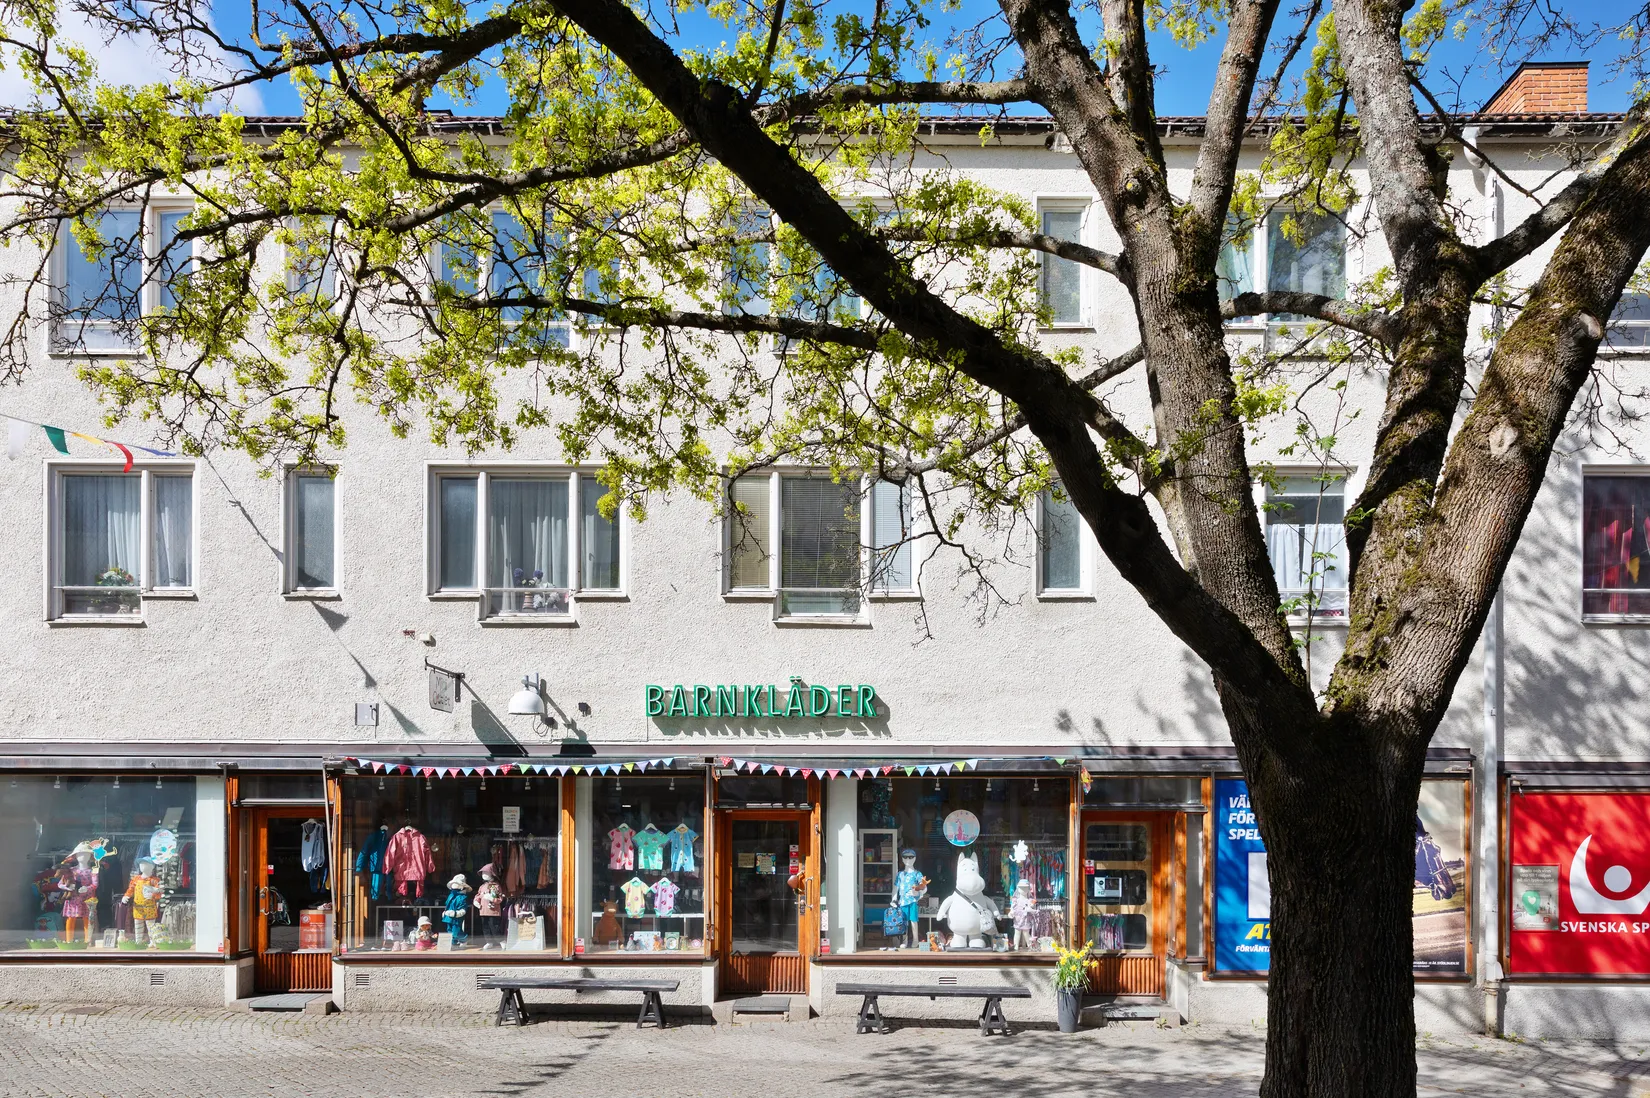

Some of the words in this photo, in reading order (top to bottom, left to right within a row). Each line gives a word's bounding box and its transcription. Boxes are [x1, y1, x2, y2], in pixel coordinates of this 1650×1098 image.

[645, 675, 877, 718] BARNKLÄDER
[1228, 810, 1256, 824] FÖR
[1228, 828, 1263, 840] SPEL
[1560, 921, 1629, 933] SVENSKA
